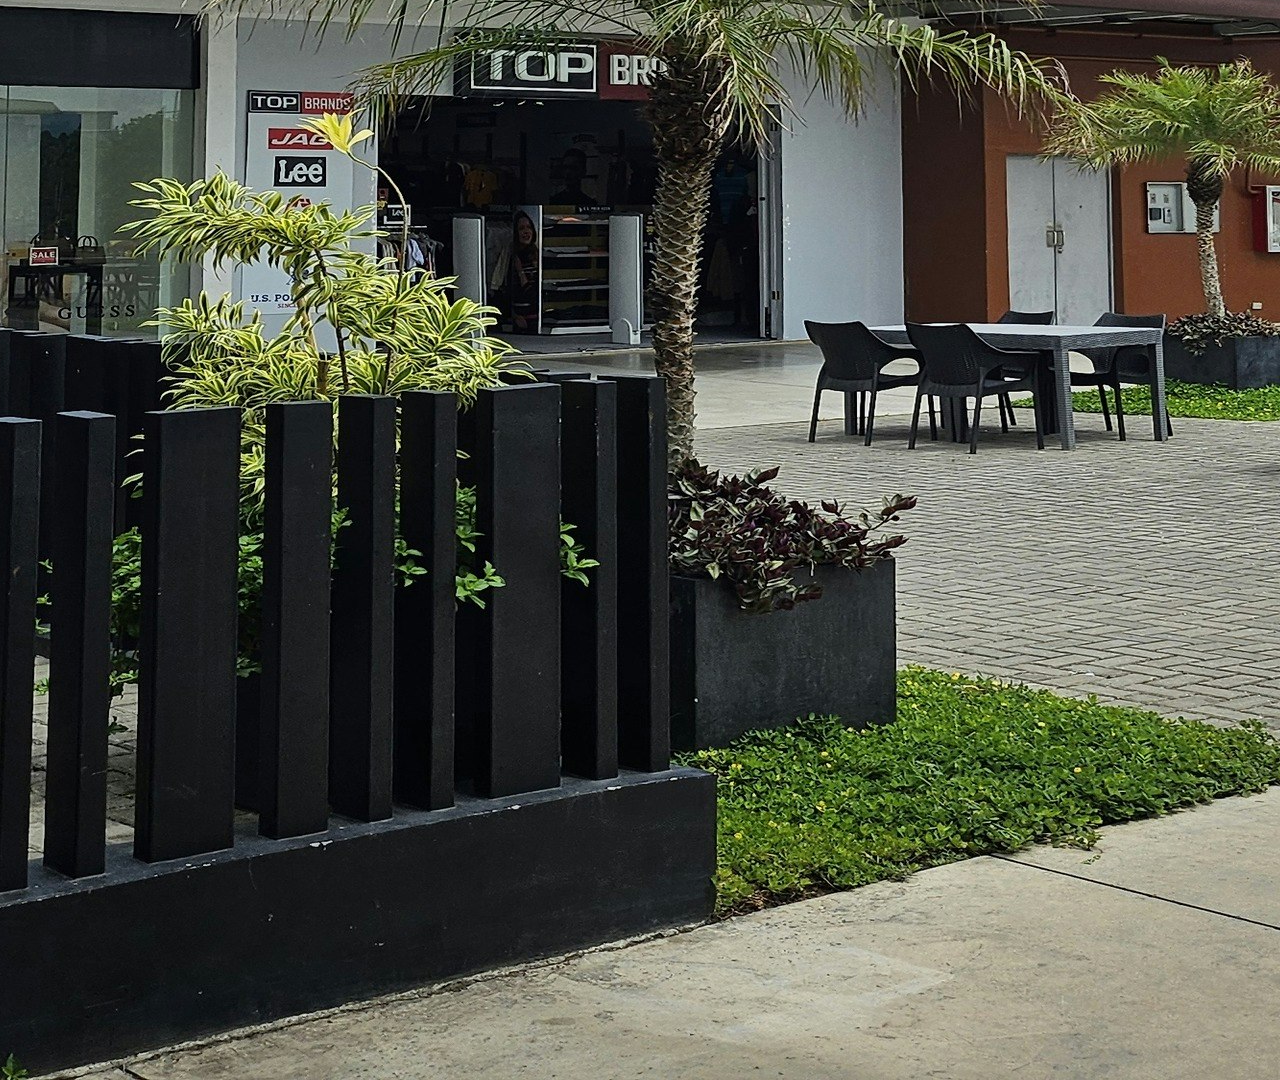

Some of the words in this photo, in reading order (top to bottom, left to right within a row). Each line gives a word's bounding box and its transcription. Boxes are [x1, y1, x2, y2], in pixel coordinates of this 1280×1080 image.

[478, 50, 594, 83] TOP
[253, 95, 297, 108] TOP
[304, 97, 352, 110] BRANDS
[270, 133, 329, 146] JAG
[278, 159, 323, 183] Lee
[31, 250, 56, 259] SALE
[275, 294, 293, 302] PO
